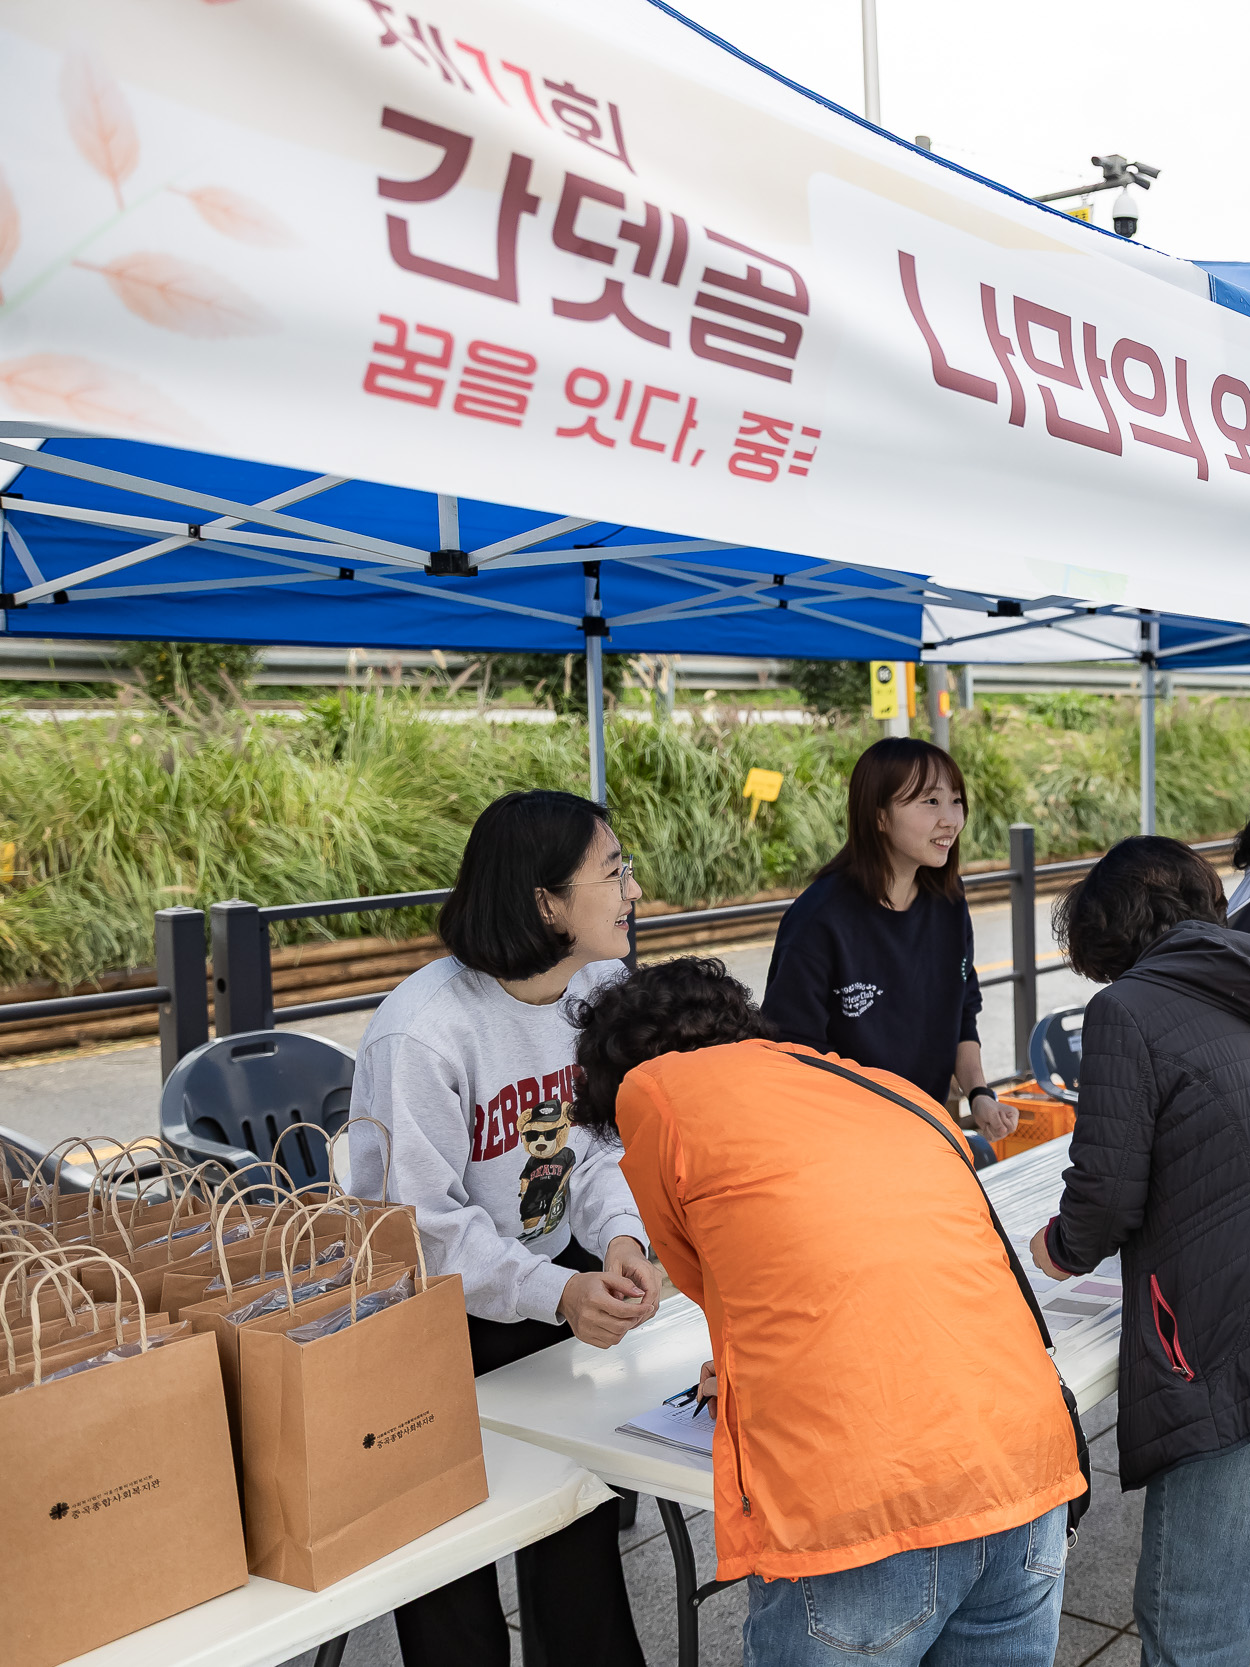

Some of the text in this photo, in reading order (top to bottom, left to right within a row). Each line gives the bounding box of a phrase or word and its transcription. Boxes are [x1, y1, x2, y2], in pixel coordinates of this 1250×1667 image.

[368, 0, 637, 176] 제77회
[377, 106, 811, 383] 간뎃골
[362, 313, 538, 428] 꿈을
[555, 367, 705, 468] 잇다,
[898, 249, 1210, 482] 나만의
[71, 1478, 160, 1519] 중곡종합사회복지관
